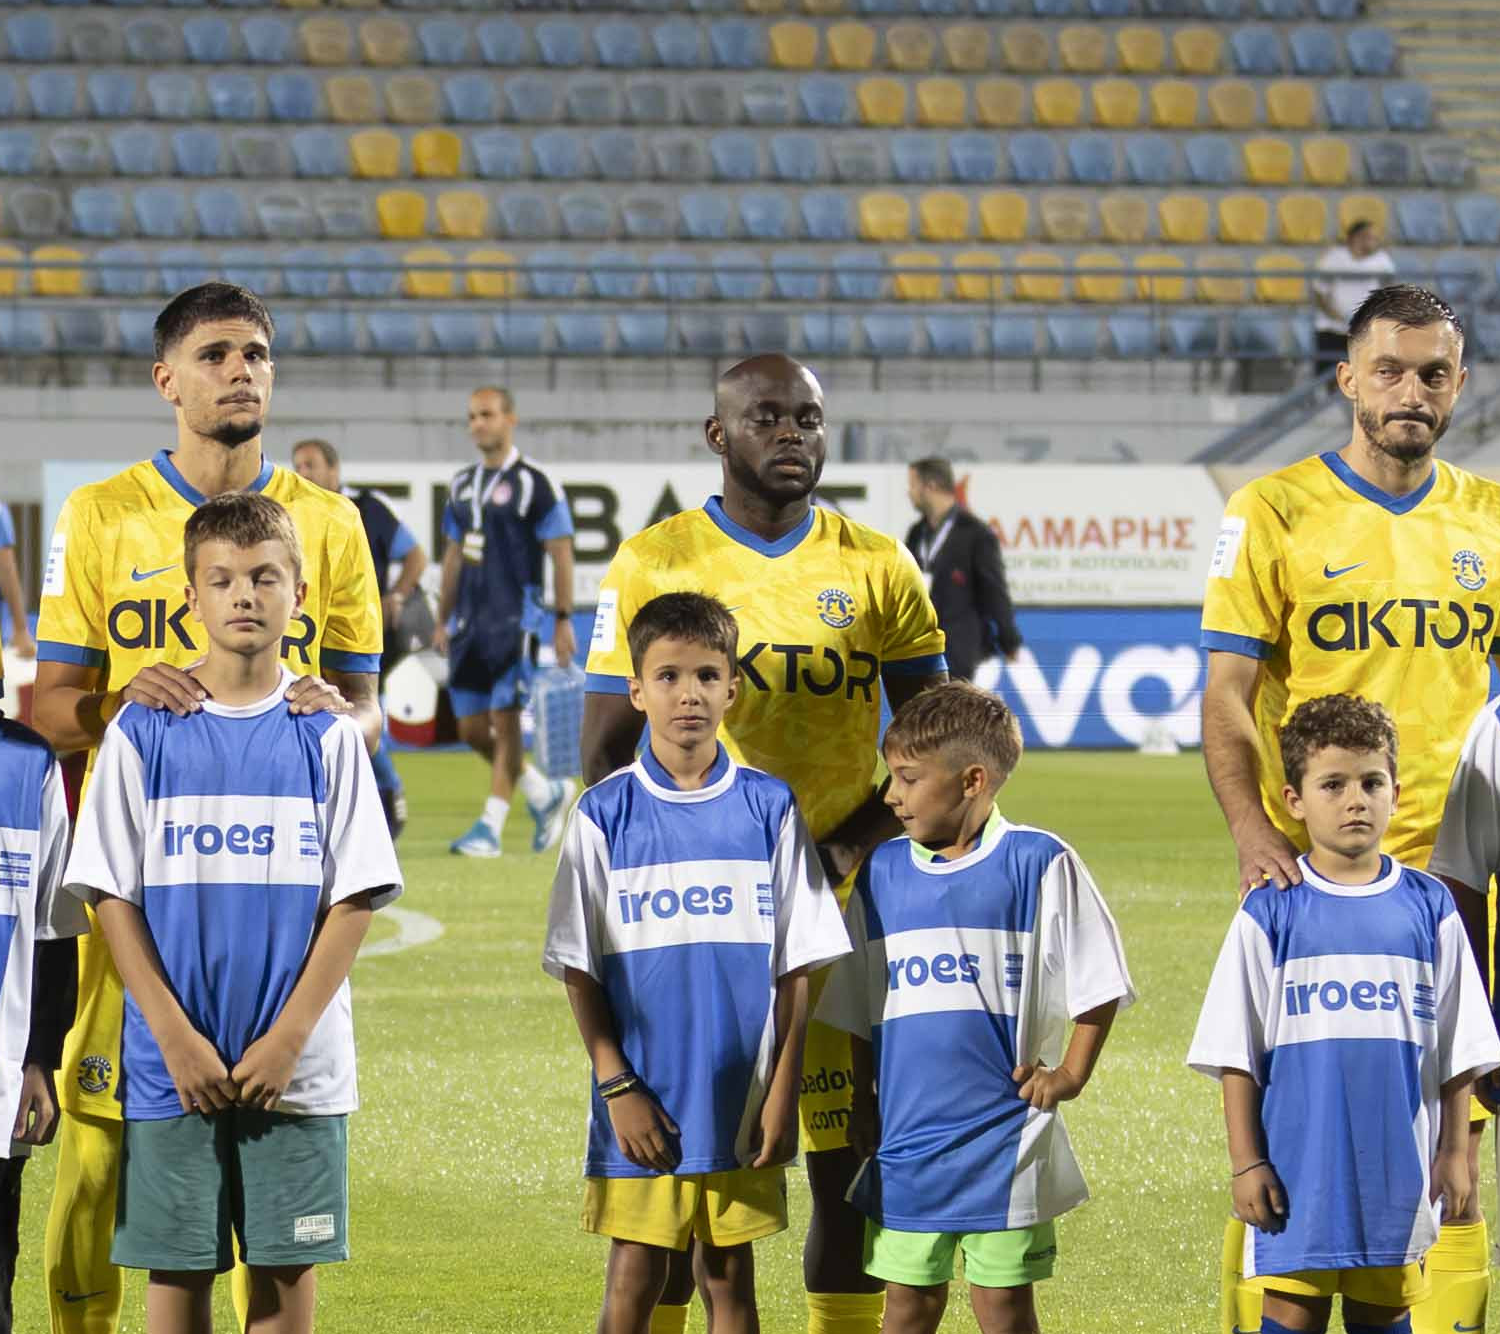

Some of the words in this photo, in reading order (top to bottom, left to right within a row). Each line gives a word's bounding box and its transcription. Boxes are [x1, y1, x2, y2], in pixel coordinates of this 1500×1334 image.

[737, 642, 879, 703] KTOR
[163, 820, 275, 857] iroes
[618, 884, 734, 925] iroes
[887, 953, 981, 991] roes
[1285, 980, 1401, 1017] iroes
